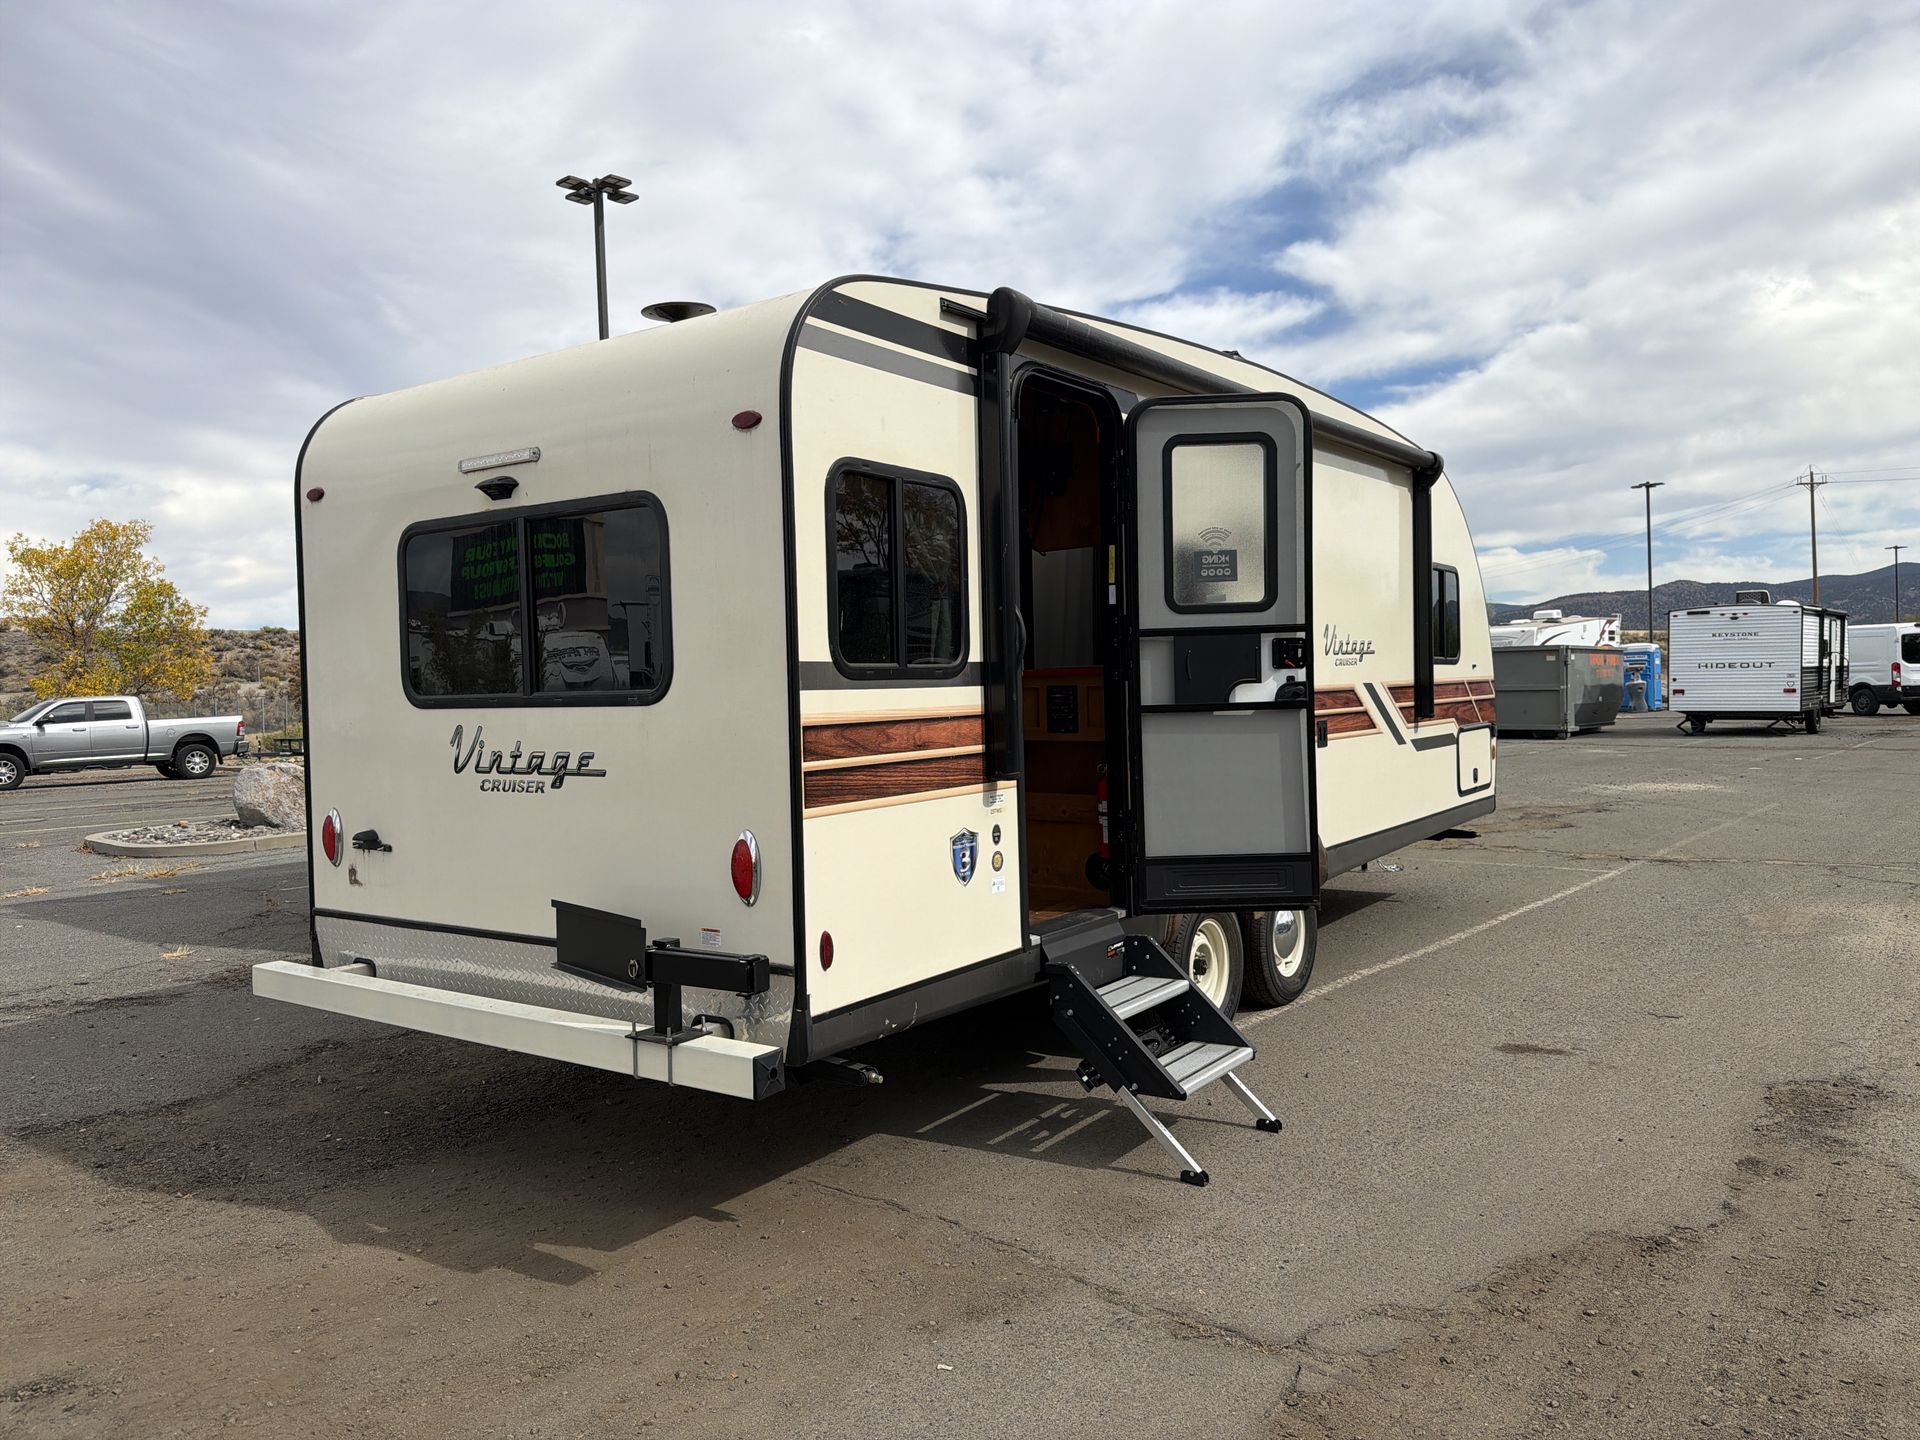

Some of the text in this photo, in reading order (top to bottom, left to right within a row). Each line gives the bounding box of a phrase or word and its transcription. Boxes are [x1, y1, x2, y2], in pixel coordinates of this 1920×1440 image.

[1323, 624, 1375, 662] Vintage
[450, 724, 607, 789] Vintage
[479, 778, 545, 794] CRUISER
